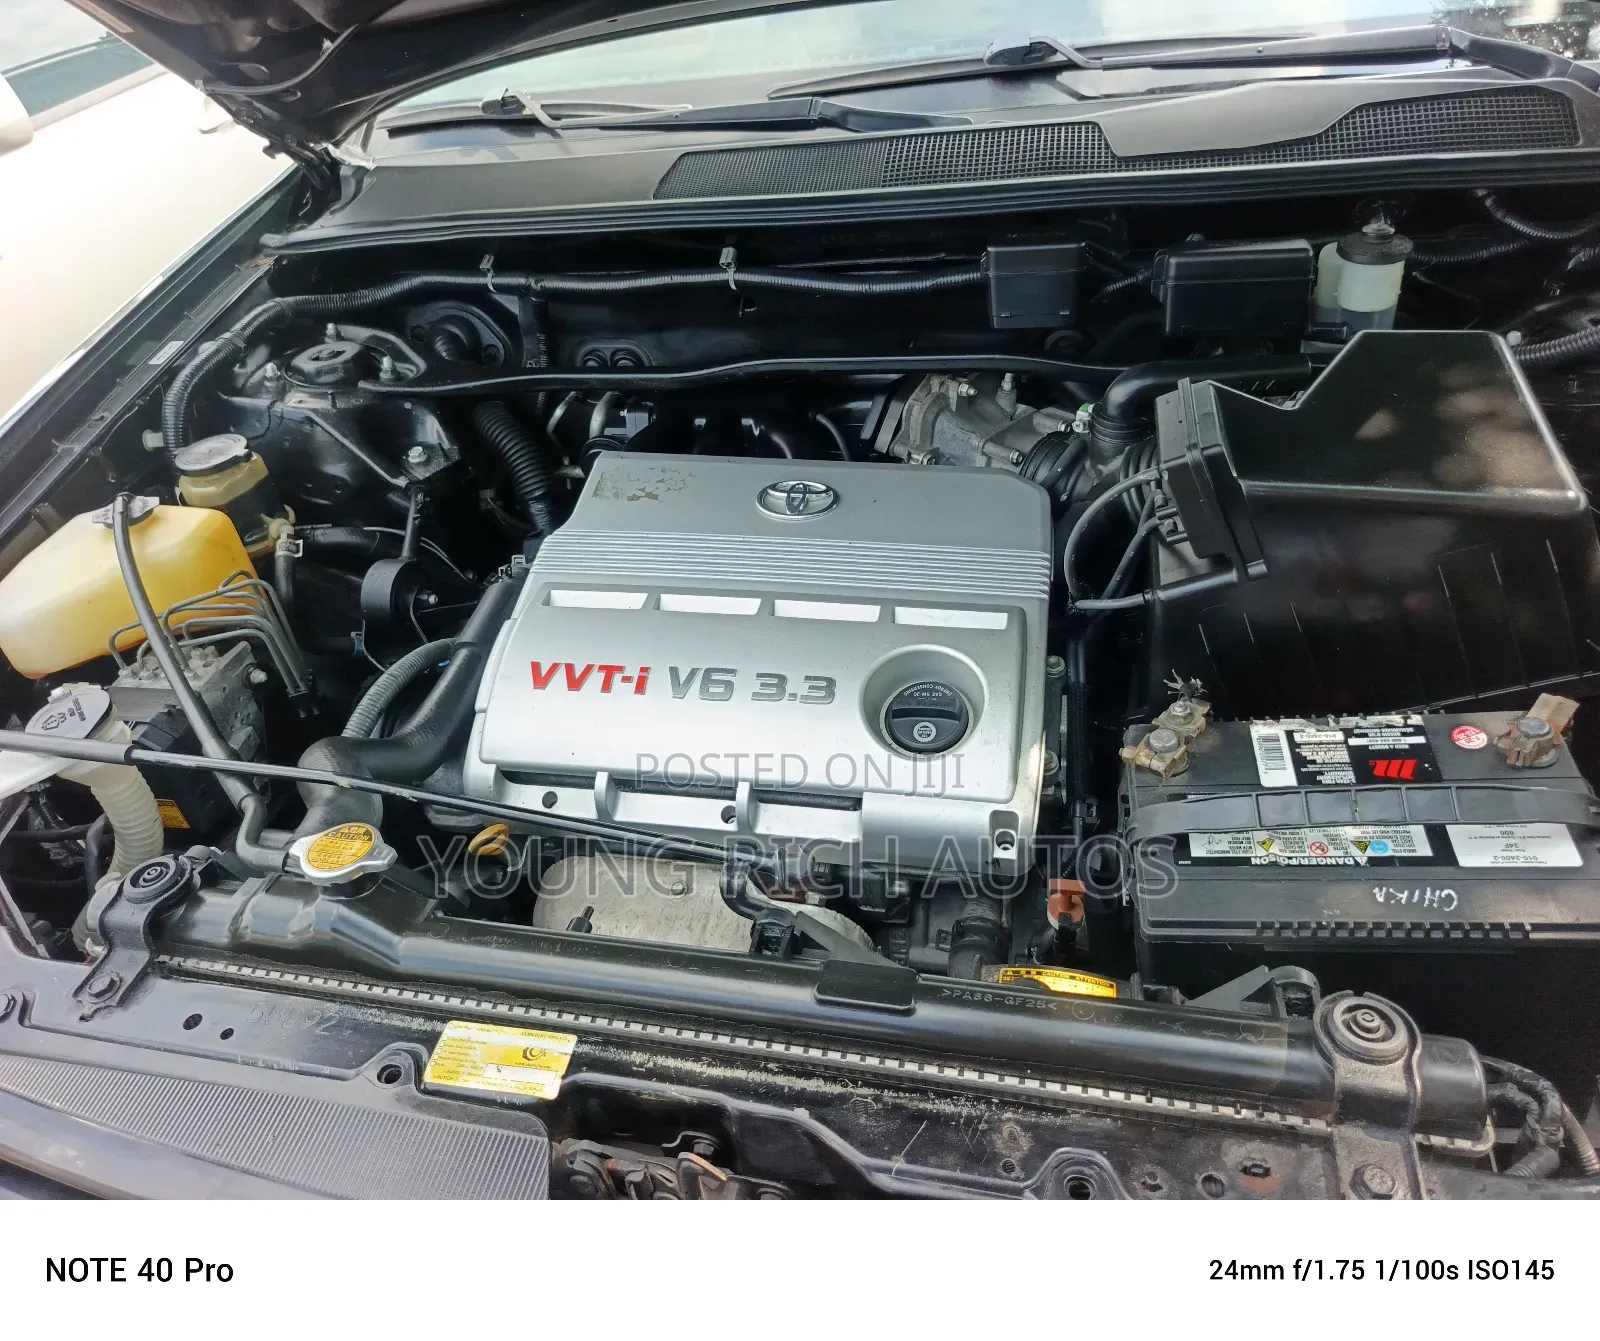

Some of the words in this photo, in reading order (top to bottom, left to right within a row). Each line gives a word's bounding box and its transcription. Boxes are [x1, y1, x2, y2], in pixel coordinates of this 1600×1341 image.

[530, 661, 651, 696] VVT-i
[668, 666, 738, 702] V6
[750, 672, 837, 705] 3.3
[1250, 853, 1356, 866] DANGER/POISON
[1373, 887, 1459, 912] CHIKA
[1042, 970, 1070, 979] CAUTION
[1075, 975, 1111, 988] ATTENTION
